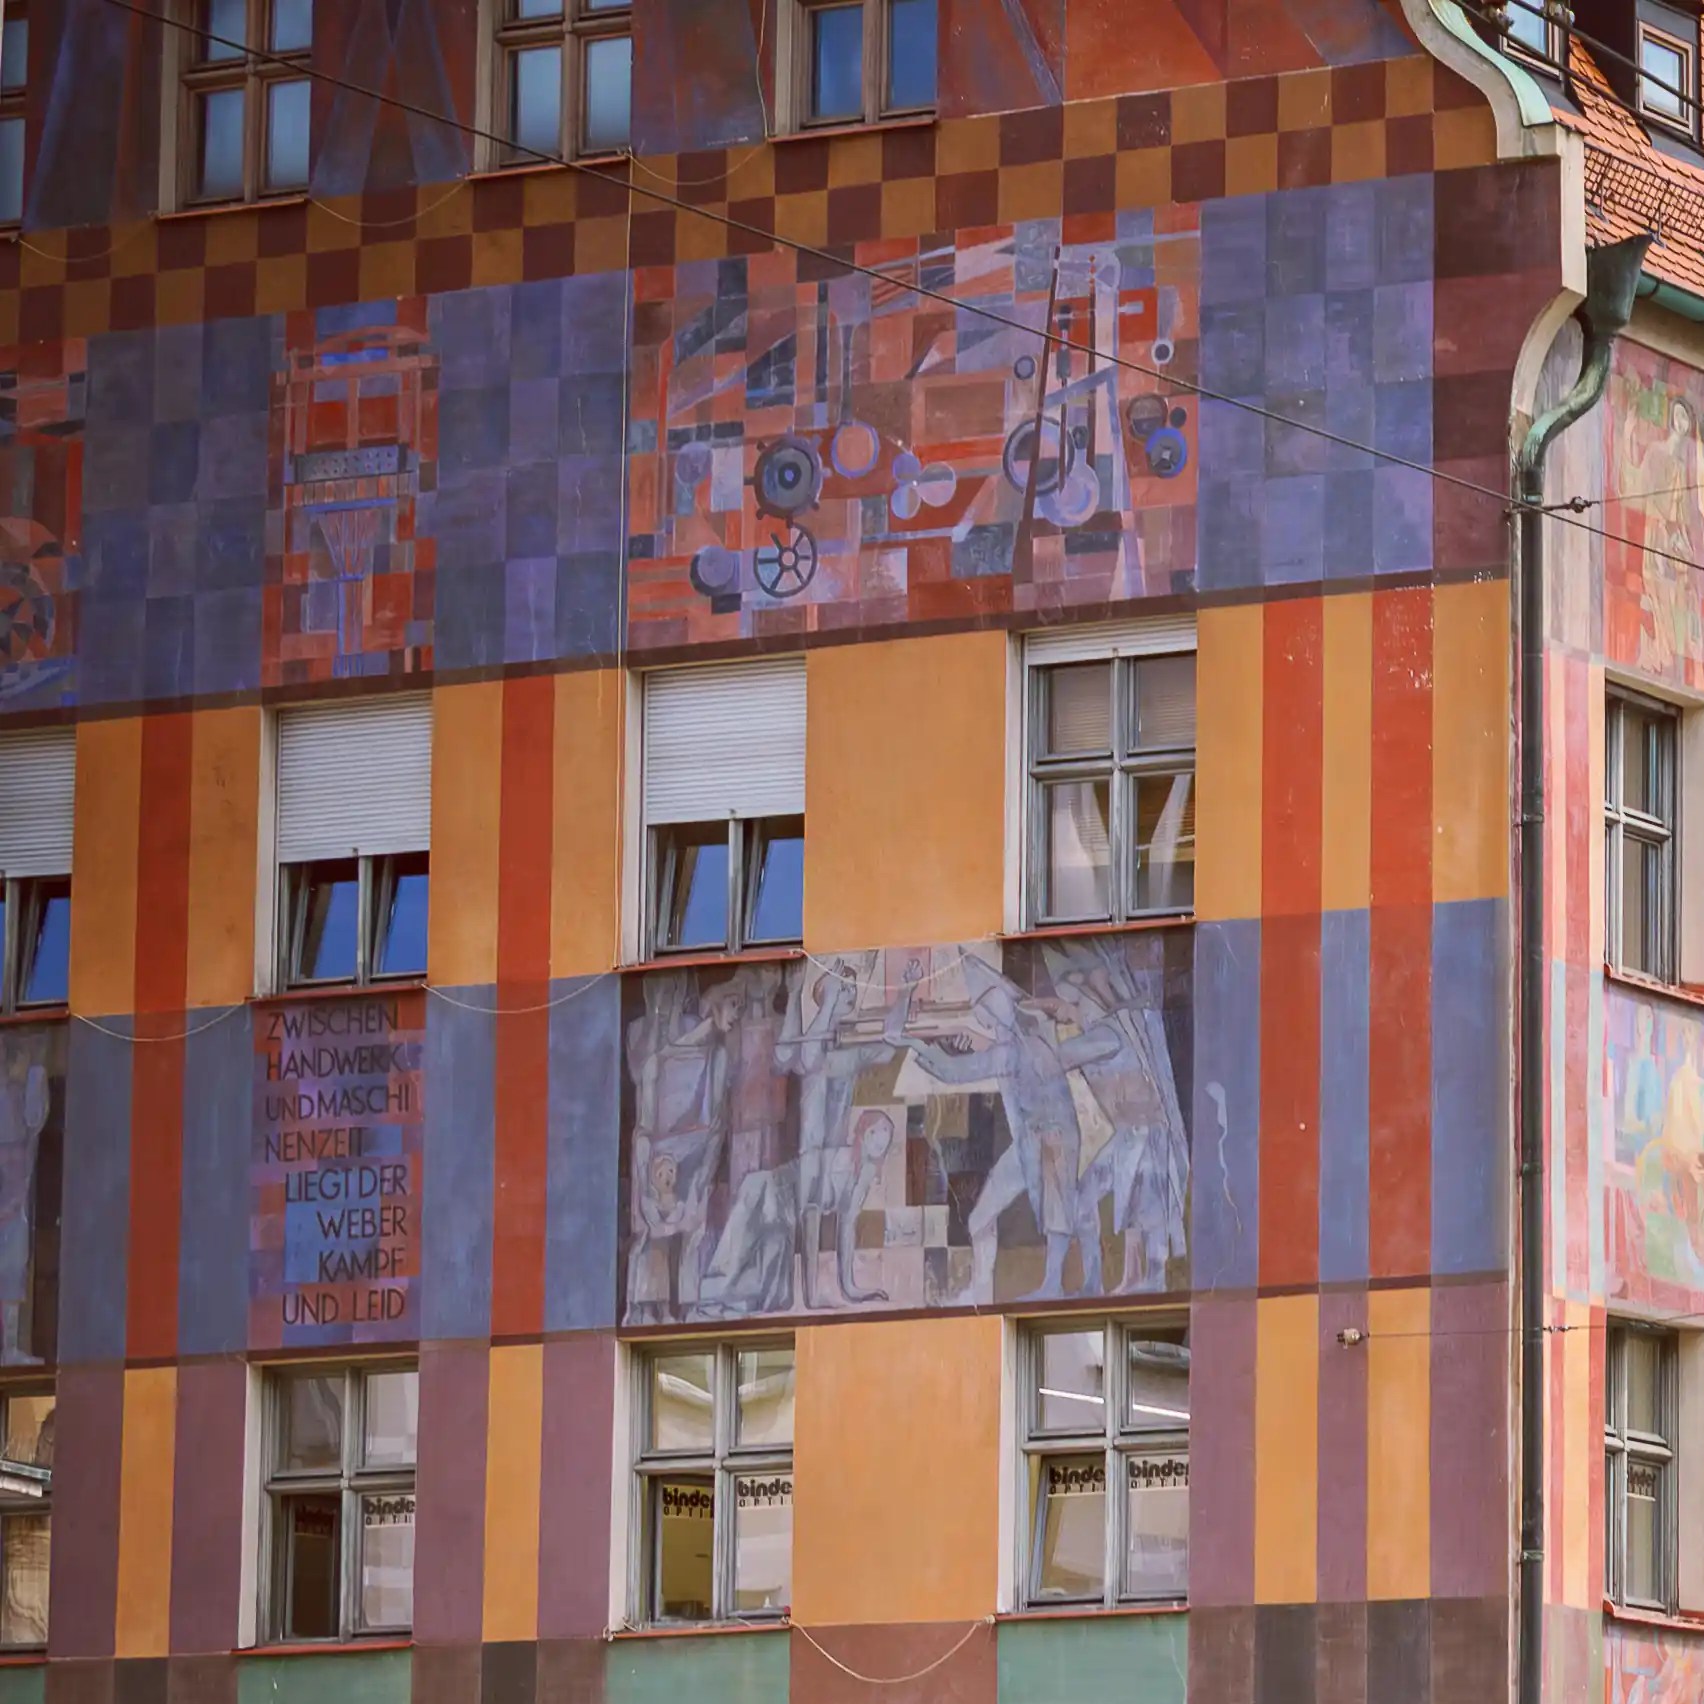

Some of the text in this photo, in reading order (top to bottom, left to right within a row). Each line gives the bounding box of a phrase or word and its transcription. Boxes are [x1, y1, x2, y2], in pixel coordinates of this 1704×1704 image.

[267, 1003, 398, 1042] ZWISCHEN
[266, 1043, 405, 1080] HANDWERK
[264, 1126, 367, 1164] NENZEIT
[285, 1164, 408, 1202] LIEGT DER
[317, 1205, 407, 1240] WEBER
[317, 1247, 405, 1283] KAMPF
[282, 1289, 406, 1325] UND LEID
